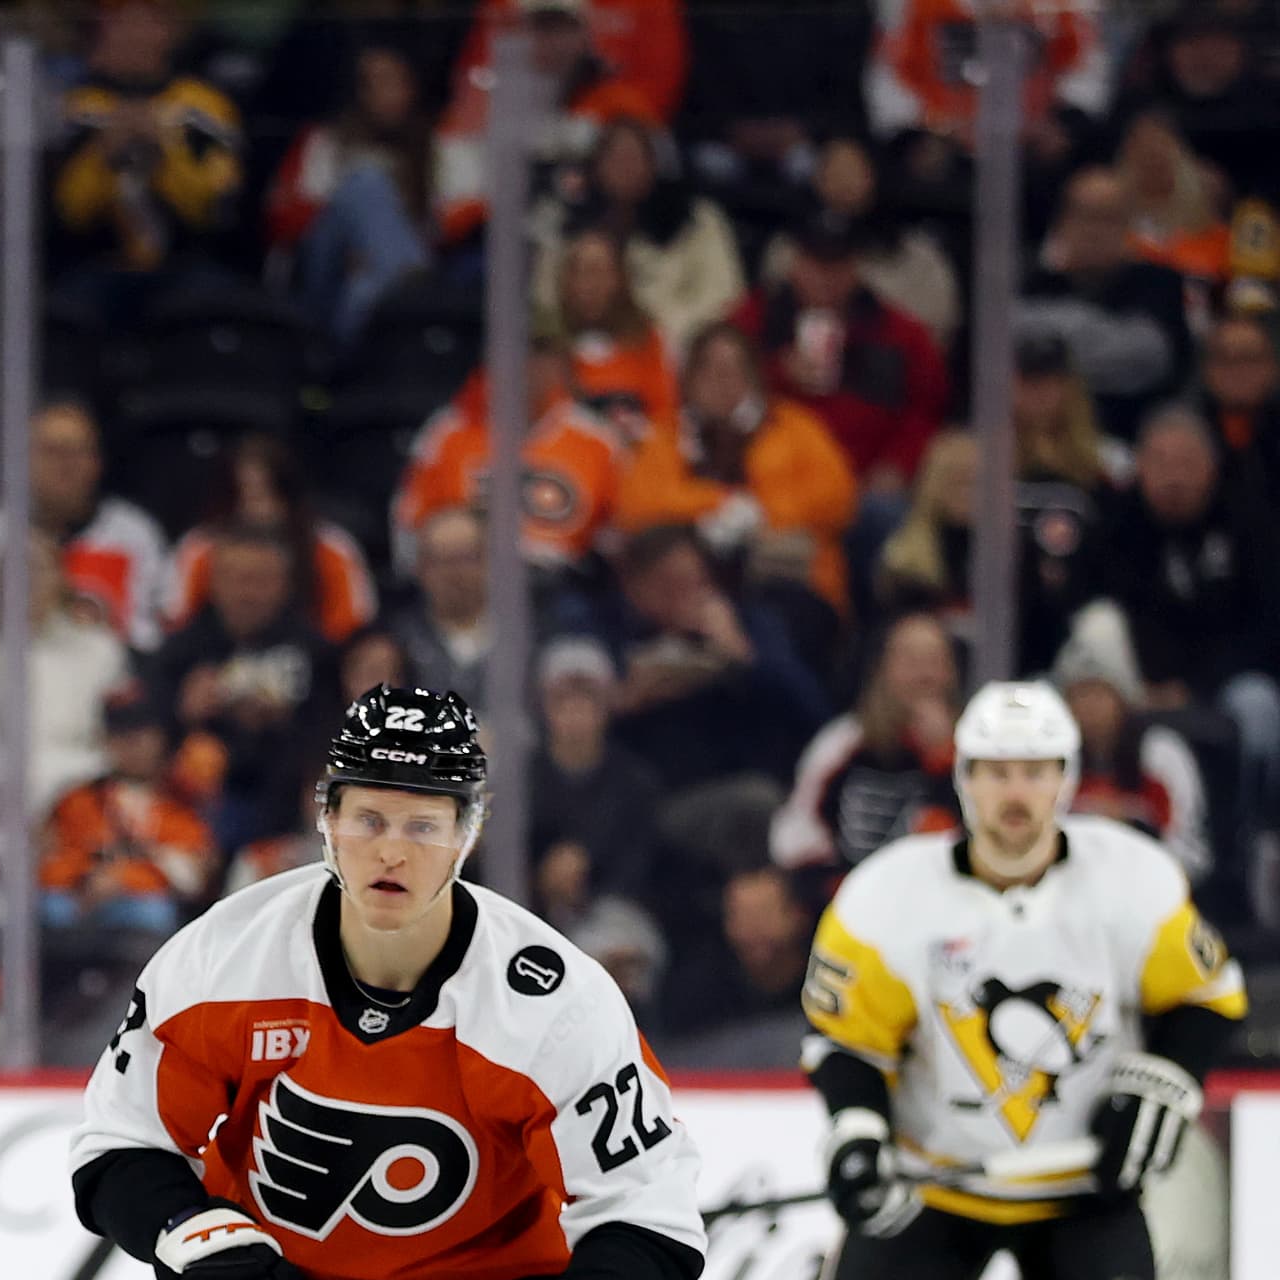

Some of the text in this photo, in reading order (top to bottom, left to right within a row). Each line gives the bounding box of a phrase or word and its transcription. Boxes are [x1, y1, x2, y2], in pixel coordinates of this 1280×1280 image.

[385, 706, 426, 732] 22
[370, 748, 428, 766] CCM
[574, 1056, 673, 1178] 22
